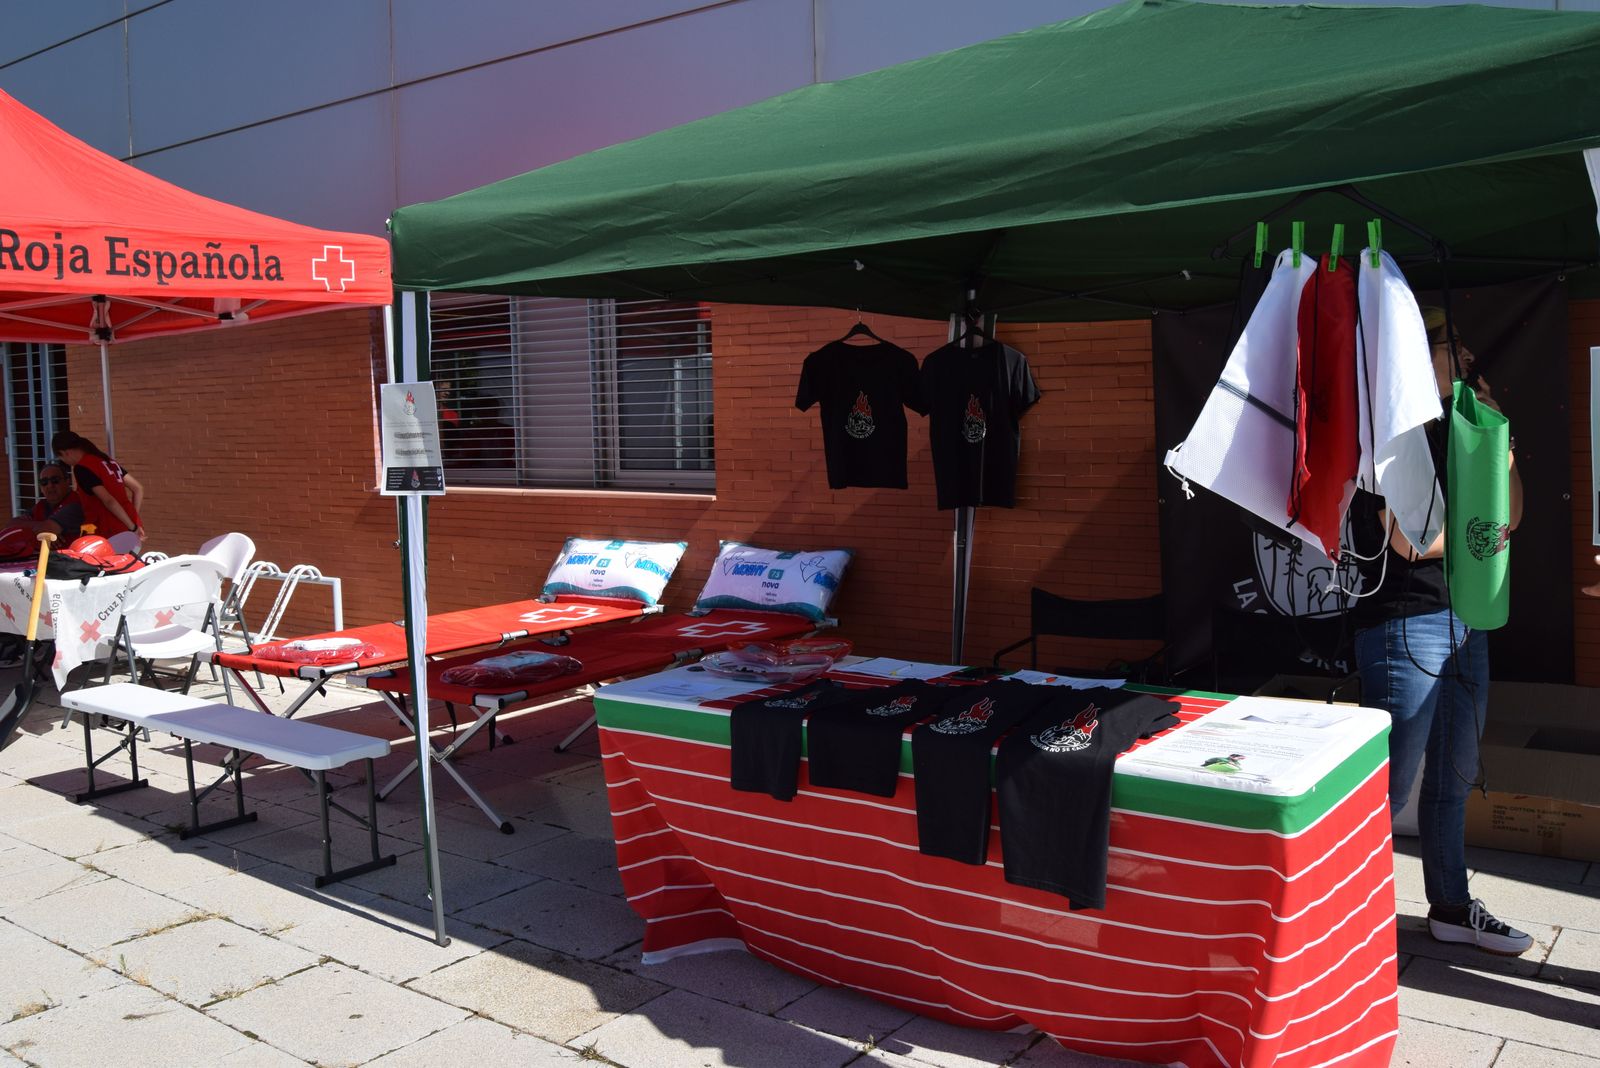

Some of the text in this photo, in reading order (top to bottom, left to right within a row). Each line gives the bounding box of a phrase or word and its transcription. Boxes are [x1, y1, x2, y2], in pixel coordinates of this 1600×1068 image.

[0, 228, 284, 286] Roja Española
[762, 581, 779, 589] nova
[1232, 577, 1257, 609] LA
[98, 600, 119, 621] Cruz
